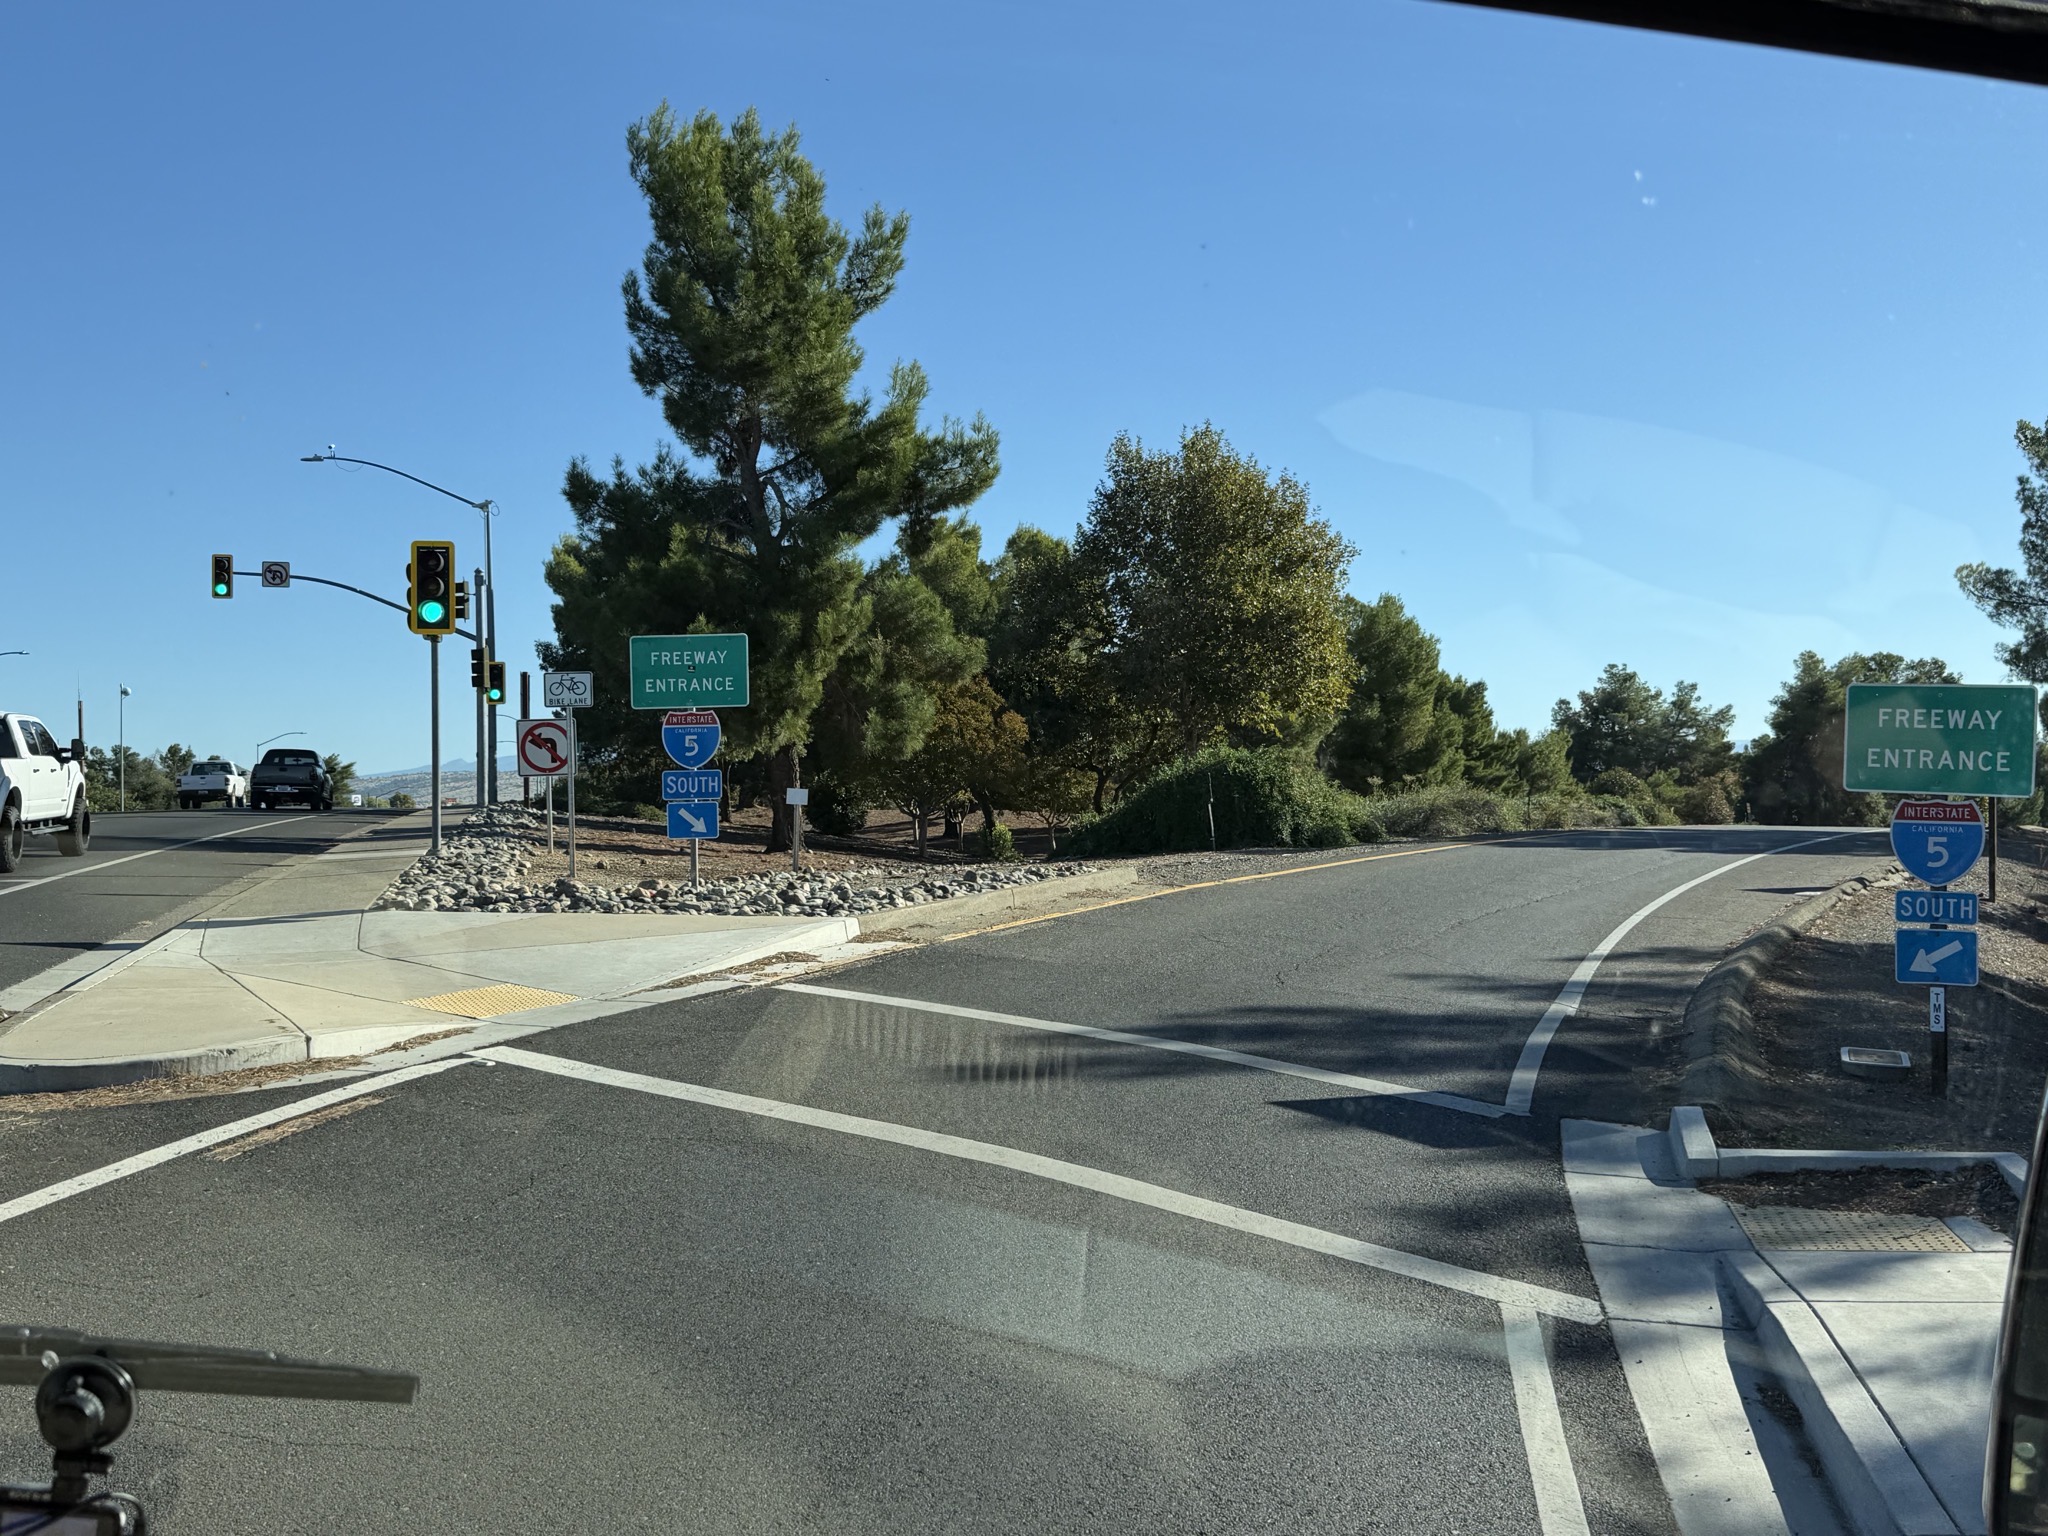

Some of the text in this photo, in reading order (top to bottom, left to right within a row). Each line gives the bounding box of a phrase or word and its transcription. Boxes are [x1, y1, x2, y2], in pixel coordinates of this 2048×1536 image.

[651, 650, 727, 665] FREEWAY
[645, 677, 734, 693] ENTRANCE
[669, 715, 713, 724] INTERSTATE
[1878, 708, 2003, 730] FREEWAY
[685, 735, 699, 757] 5
[1867, 748, 2010, 772] ENTRANCE
[666, 776, 718, 794] SOUTH
[1904, 806, 1971, 819] INTERSTATE
[1911, 825, 1964, 833] CALIFORNIA
[1927, 837, 1949, 868] 5
[1900, 896, 1973, 919] SOUTH
[1933, 993, 1942, 1025] TMS
